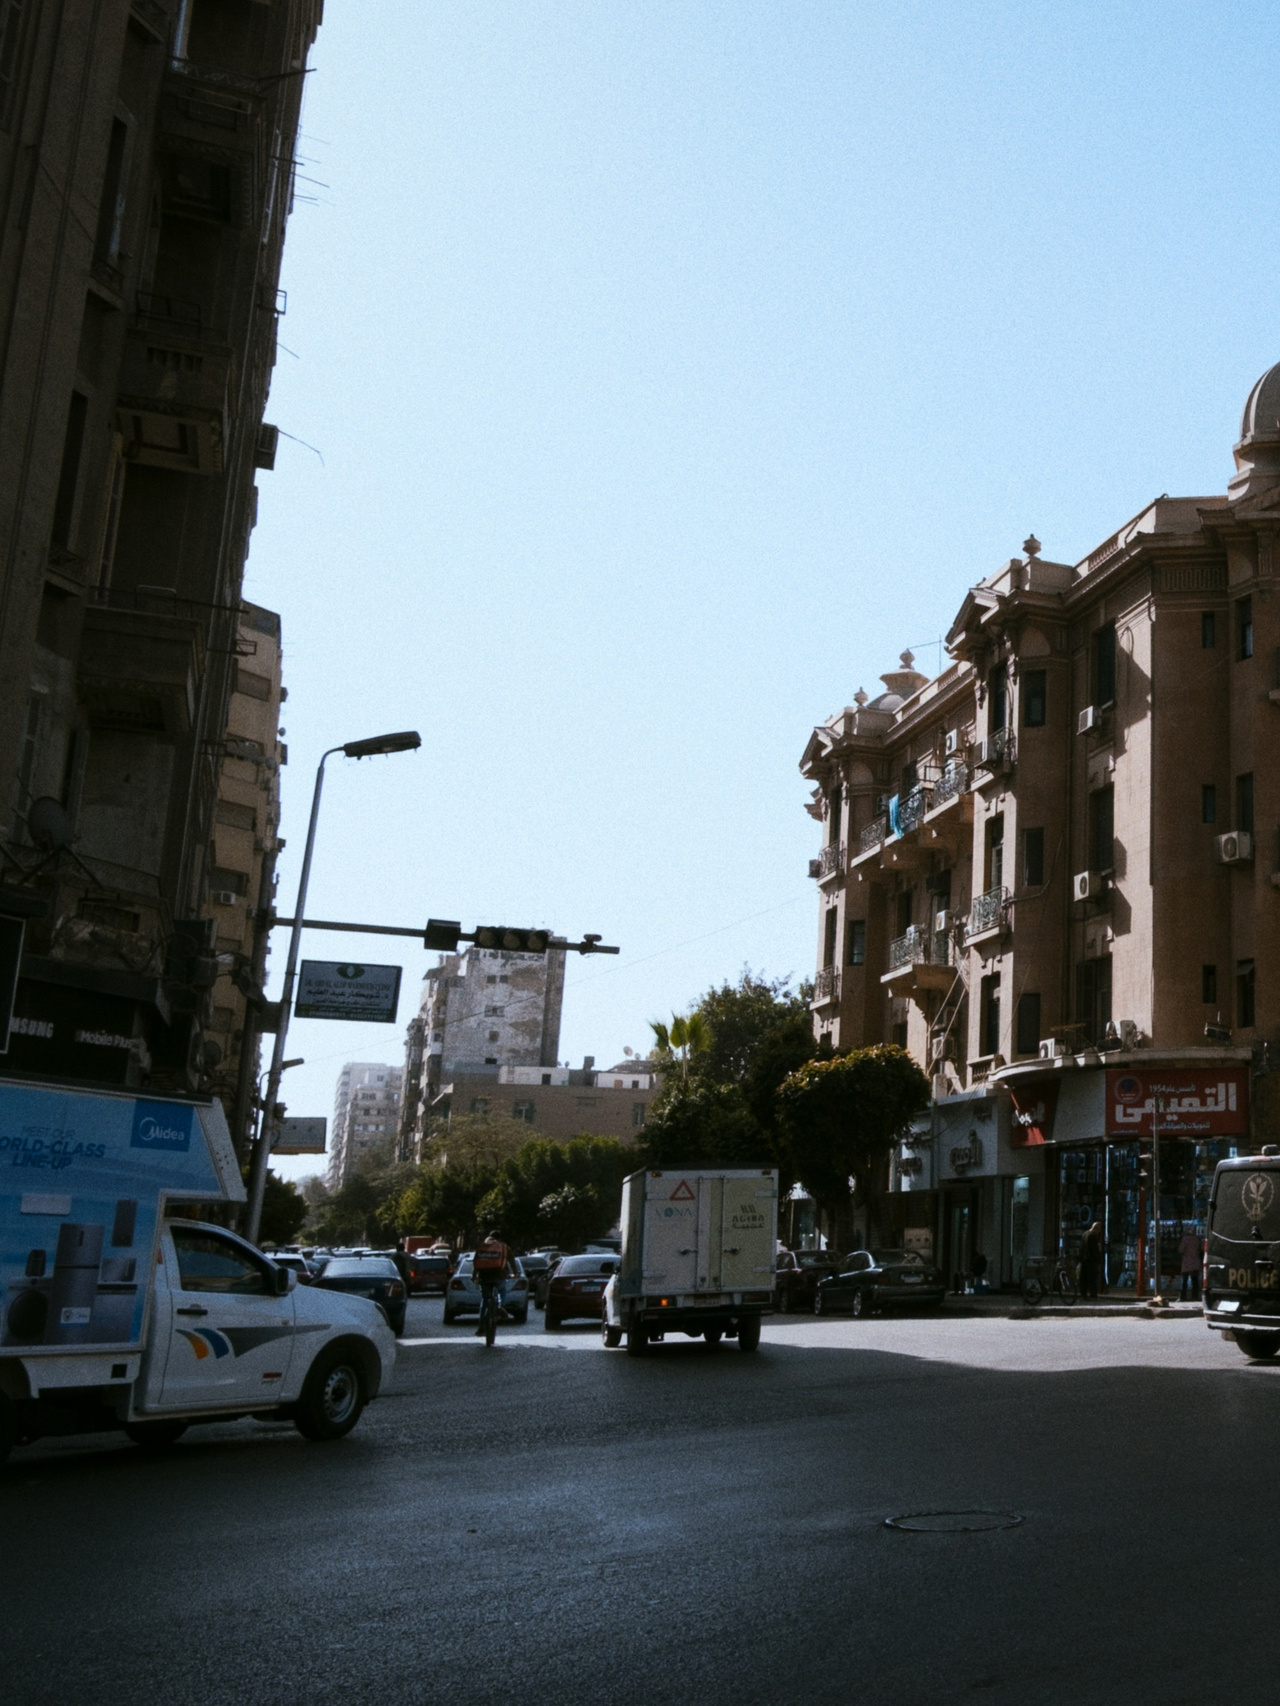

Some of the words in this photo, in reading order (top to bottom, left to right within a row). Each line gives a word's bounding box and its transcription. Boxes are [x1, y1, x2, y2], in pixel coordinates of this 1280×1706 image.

[80, 1029, 113, 1046] Mobile
[146, 1126, 186, 1142] Midea
[12, 1154, 72, 1170] LINE-UP
[1228, 1267, 1279, 1289] POLICE
